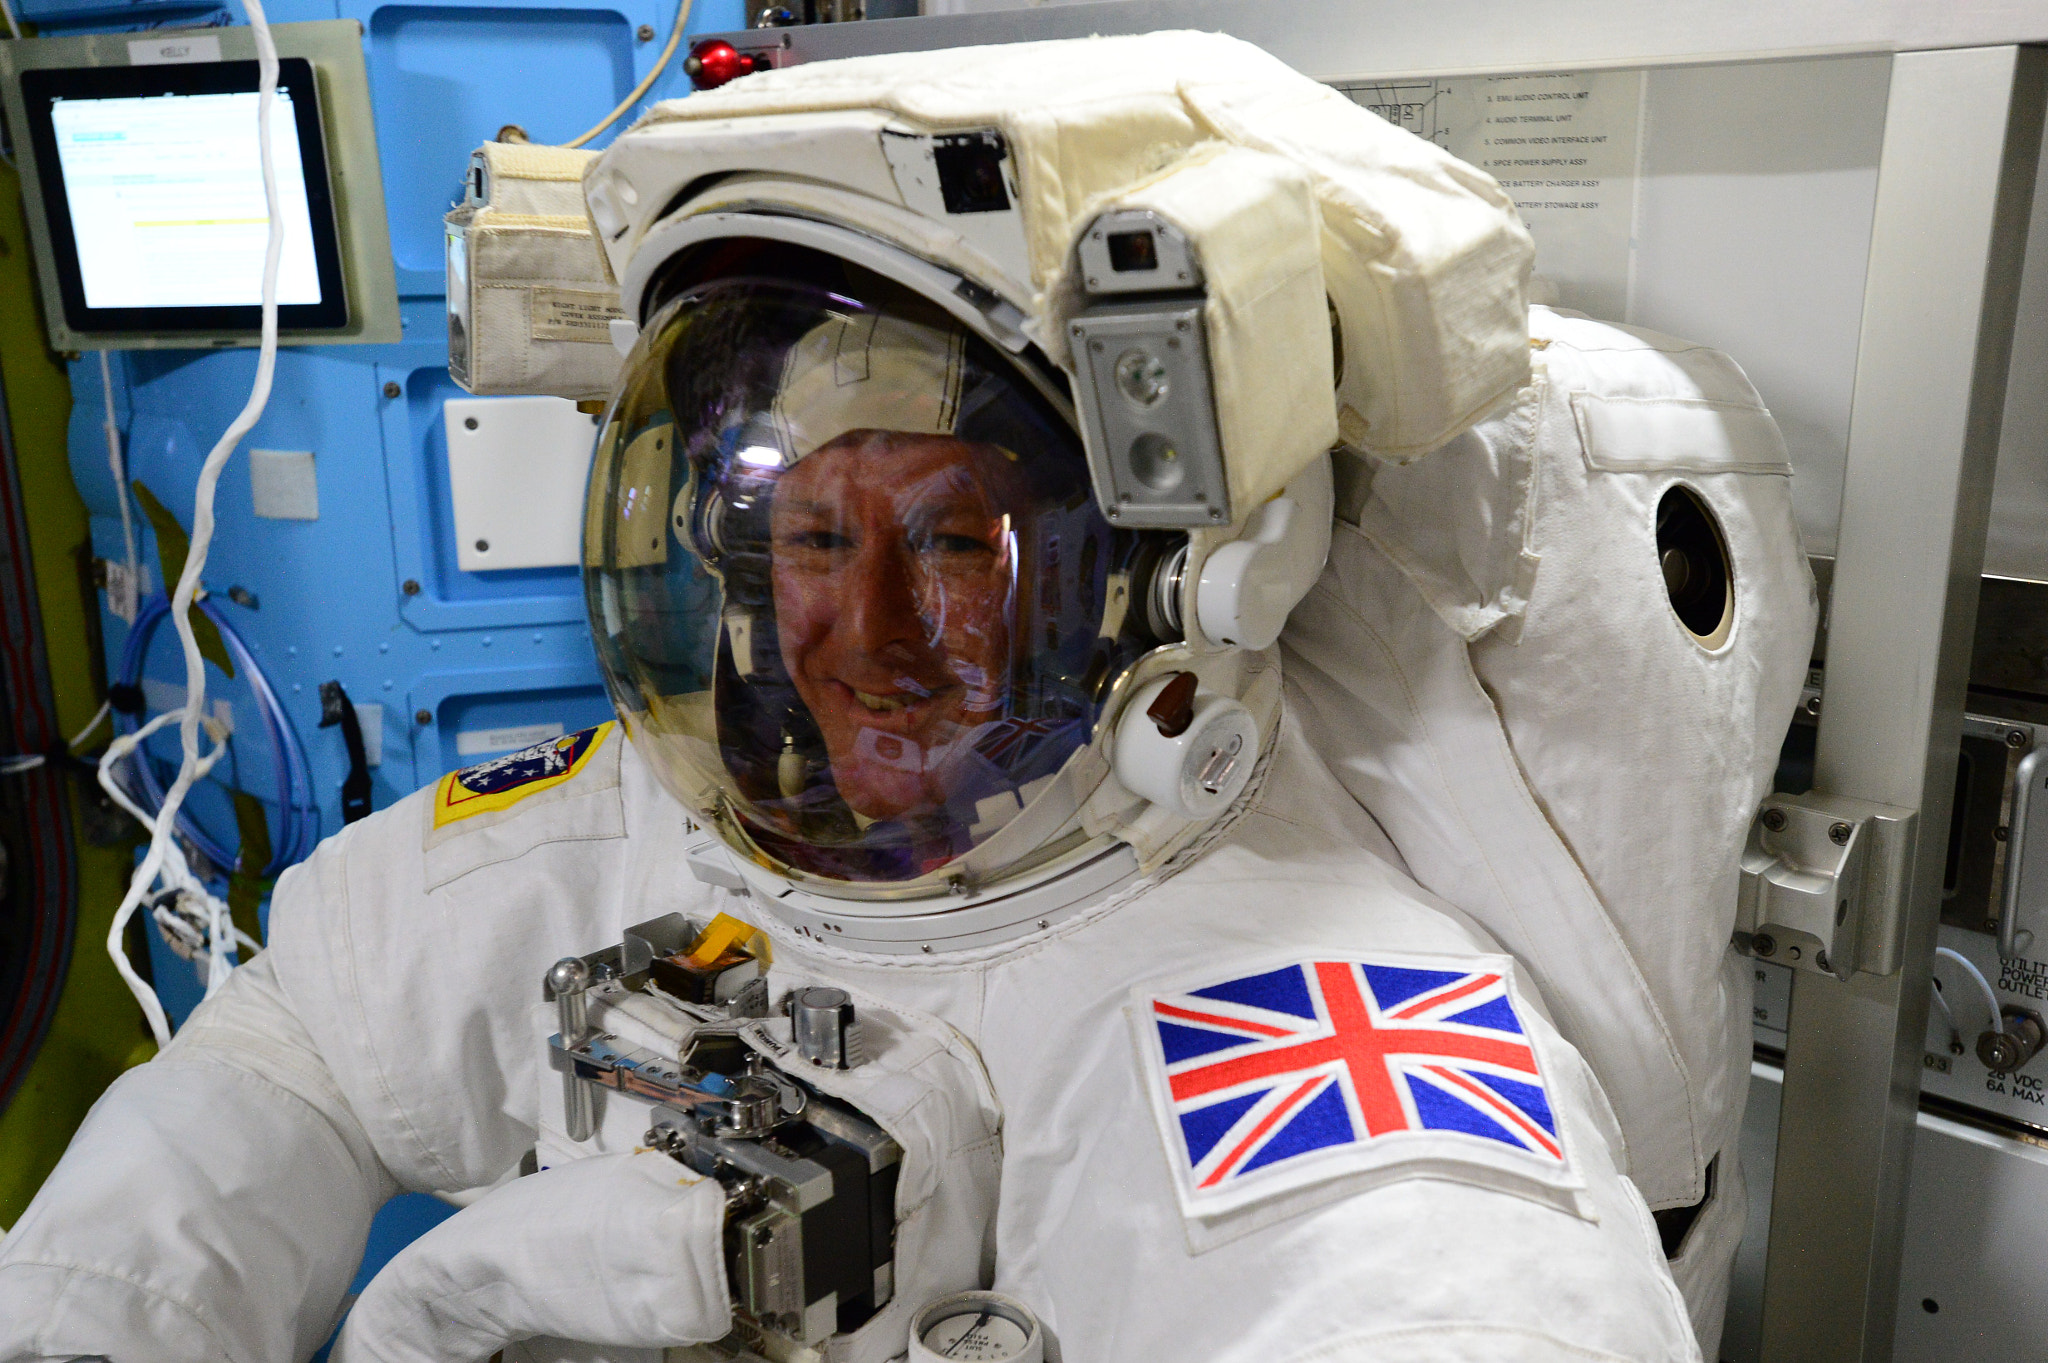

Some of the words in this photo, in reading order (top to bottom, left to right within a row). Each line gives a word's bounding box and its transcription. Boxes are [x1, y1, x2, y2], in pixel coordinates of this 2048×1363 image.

[1537, 92, 1571, 100] CONTROL
[1573, 91, 1589, 99] UNIT
[1555, 114, 1572, 122] UNIT
[1528, 137, 1550, 145] VIDEO
[1551, 136, 1589, 144] INTERFACE
[1591, 135, 1607, 143] UNIT
[1541, 158, 1568, 166] SUPPLY
[1569, 158, 1587, 166] ASSY
[1544, 201, 1579, 209] STOWAGE
[578, 304, 601, 312] LIGHT
[1998, 978, 2048, 1001] OUTLE
[2013, 1072, 2043, 1091] VDC
[1986, 1079, 2006, 1095] 6A
[2012, 1086, 2046, 1106] MAX
